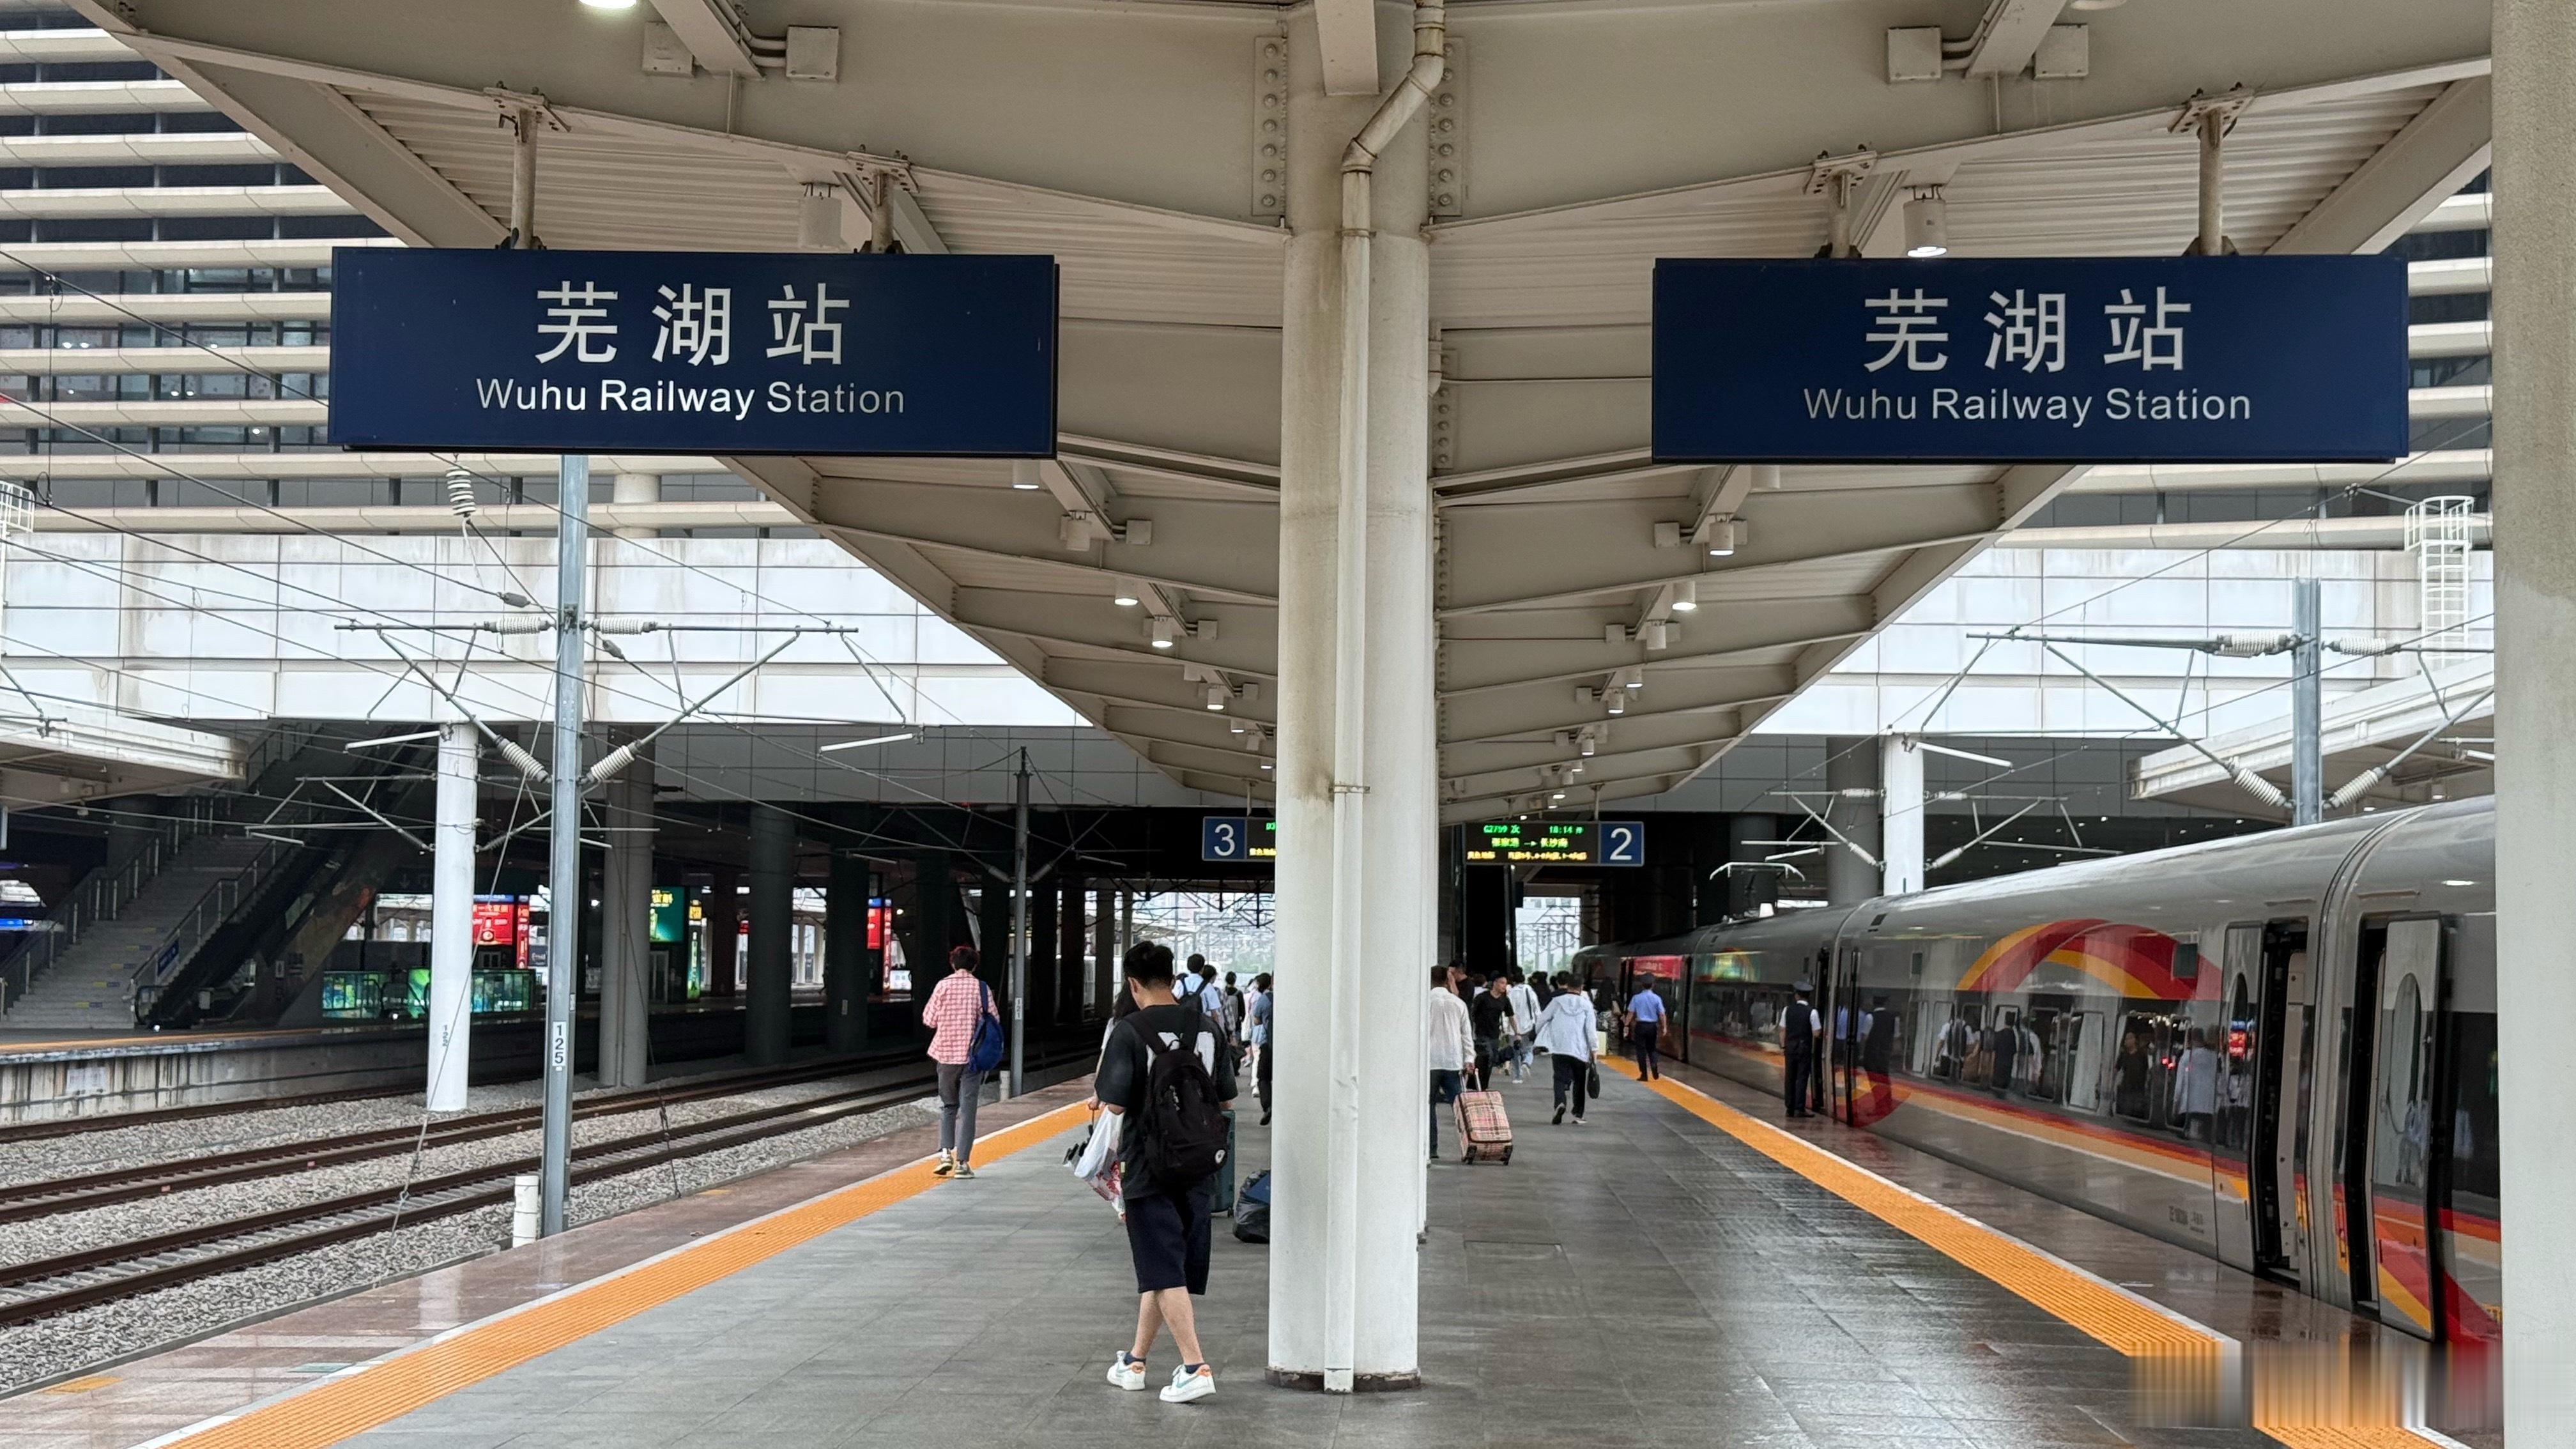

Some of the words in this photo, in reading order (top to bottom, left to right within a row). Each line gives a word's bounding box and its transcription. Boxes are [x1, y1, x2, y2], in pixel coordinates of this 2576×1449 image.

[535, 280, 849, 366] 芜湖站
[1864, 288, 2192, 372] 芜湖站
[477, 378, 586, 411] Wuhu
[600, 379, 755, 421] Railway
[767, 381, 905, 413] Station
[1804, 388, 1916, 420] Wuhu
[1932, 388, 2092, 428] Railway
[2105, 388, 2251, 420] Station
[1213, 823, 1236, 857] 3
[1609, 827, 1632, 861] 2
[555, 1024, 564, 1064] 125
